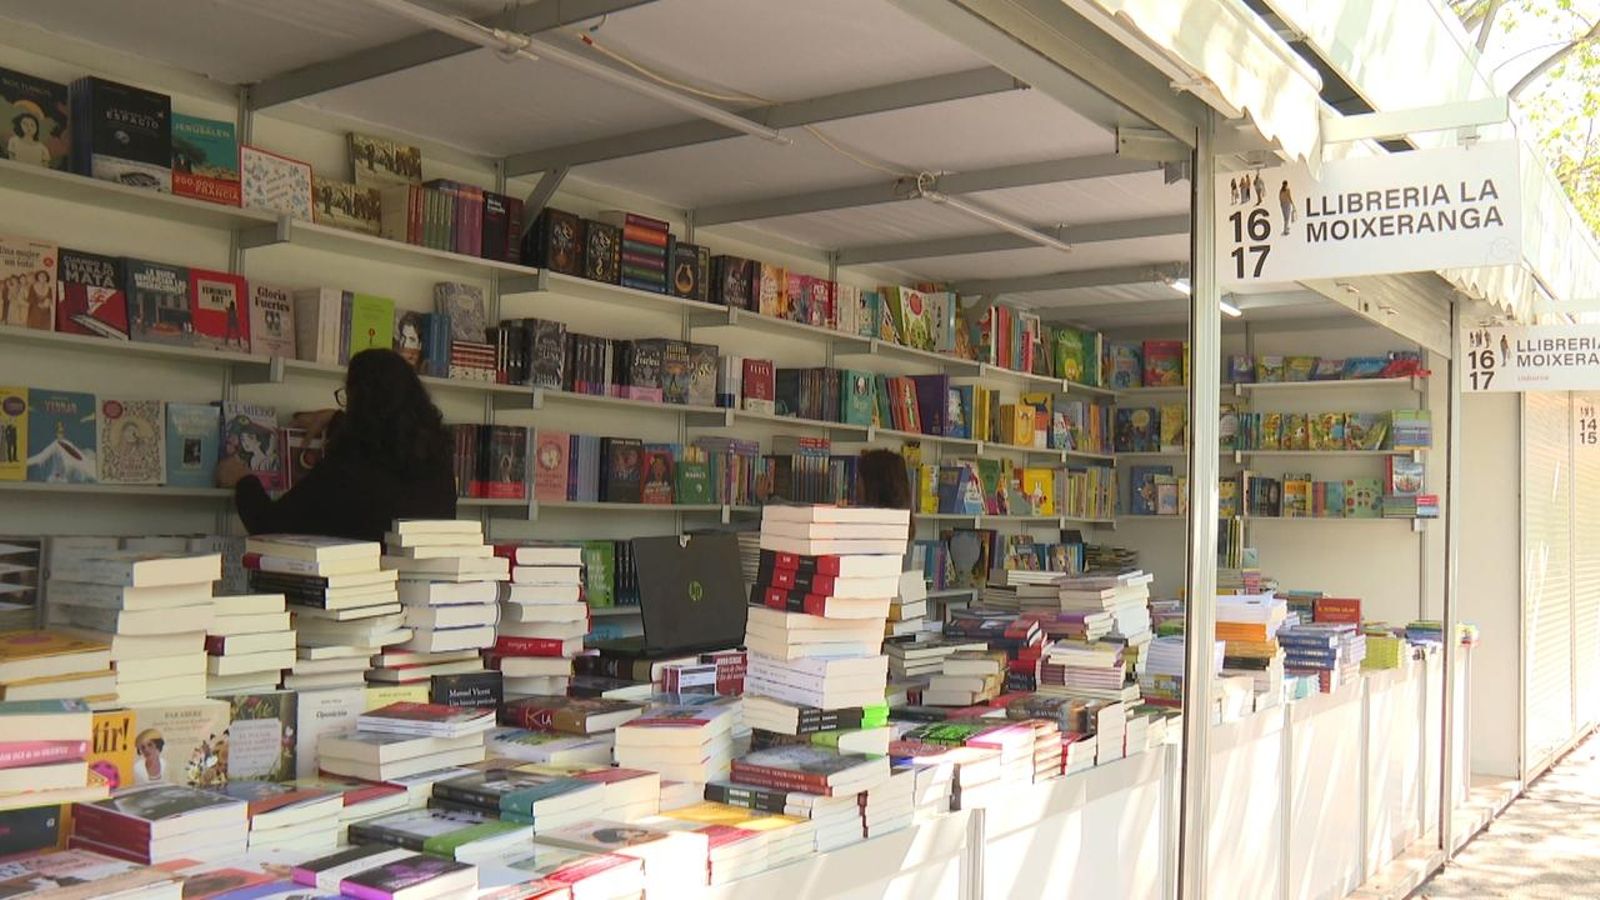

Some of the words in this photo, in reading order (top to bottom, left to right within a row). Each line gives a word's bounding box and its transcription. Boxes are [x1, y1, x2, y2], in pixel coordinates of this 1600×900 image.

[195, 184, 239, 200] FRANCIA
[1305, 183, 1449, 218] LLIBRERIA
[1460, 179, 1498, 203] LA
[1228, 208, 1271, 243] 16
[1306, 206, 1503, 243] MOIXERANGA
[1230, 245, 1271, 279] 17
[66, 270, 115, 289] MATA
[257, 286, 287, 301] Gloria
[255, 297, 291, 312] Fuertes
[1517, 337, 1600, 352] LLIBRERI
[1468, 349, 1495, 370] 16
[1517, 353, 1600, 368] MOIXERA
[1469, 371, 1495, 390] 17
[1580, 418, 1597, 431] 14
[1580, 432, 1597, 445] 15
[689, 580, 703, 602] hp
[449, 687, 471, 698] Manuel
[472, 687, 490, 697] Vicent
